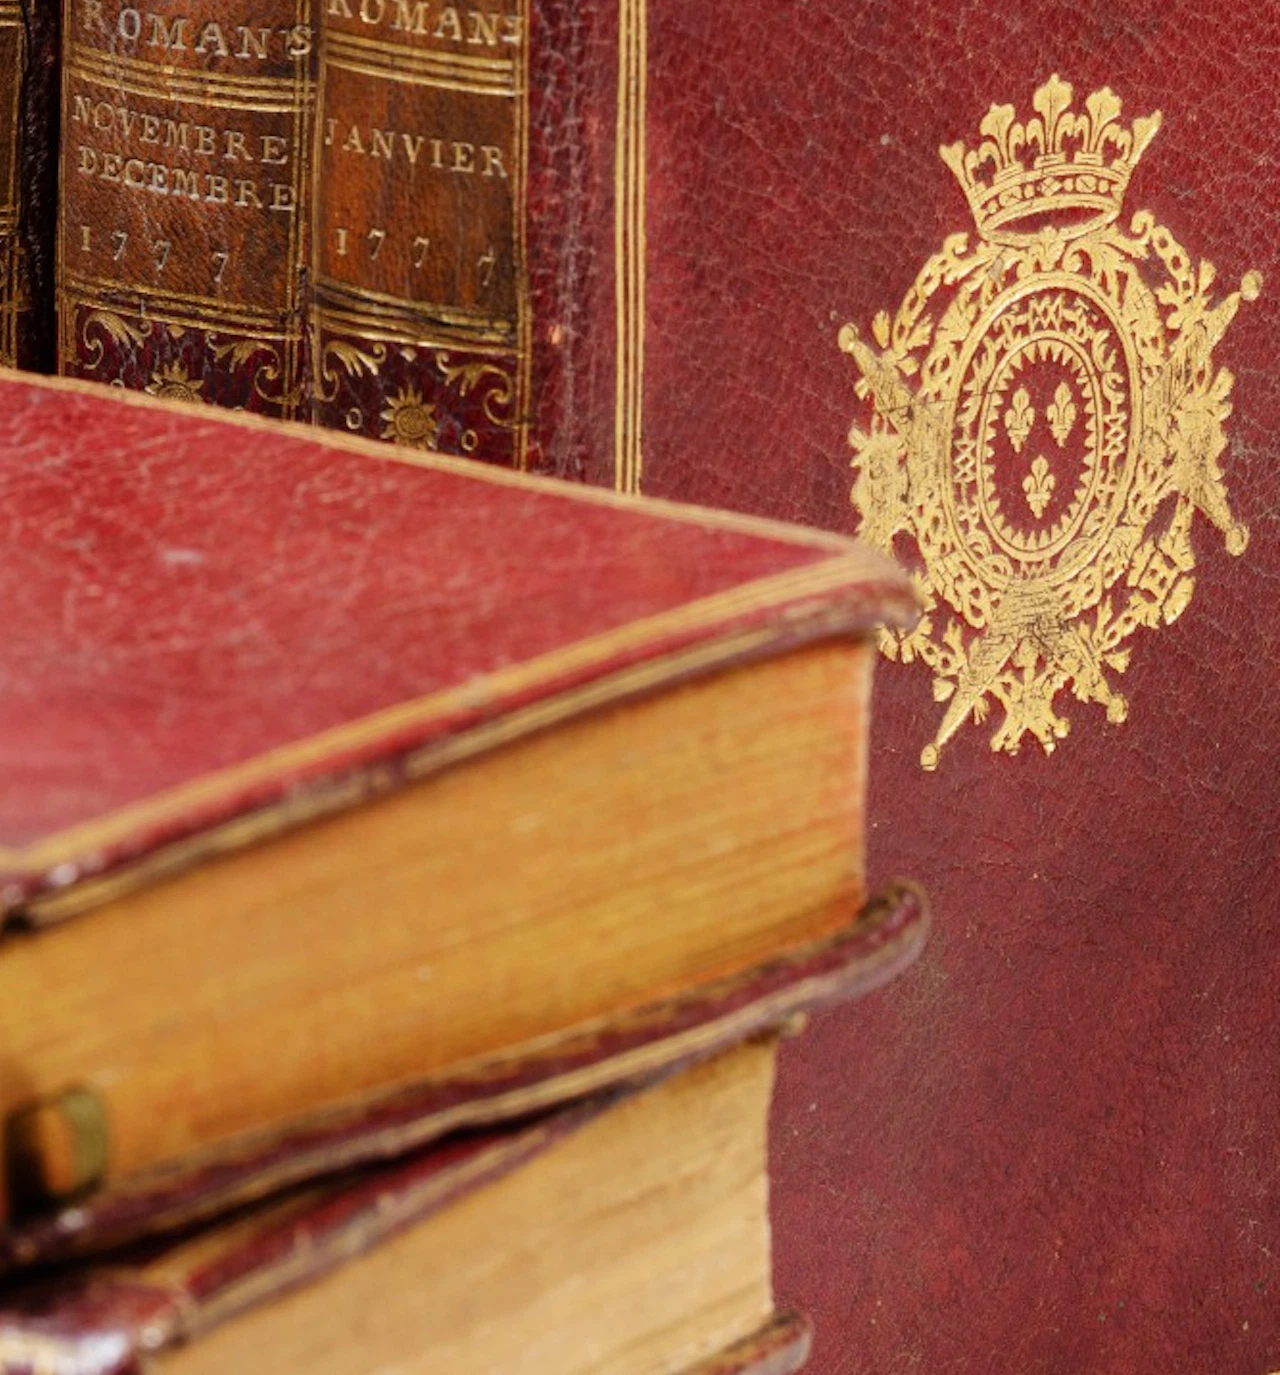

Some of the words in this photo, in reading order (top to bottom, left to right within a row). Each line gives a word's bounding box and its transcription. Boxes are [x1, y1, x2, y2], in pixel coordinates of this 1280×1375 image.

[73, 95, 288, 165] NOVEMBRE
[324, 118, 508, 178] JANVIER
[78, 144, 297, 212] DECEMBRE
[81, 226, 228, 283] 1777
[336, 228, 496, 287] 1777
